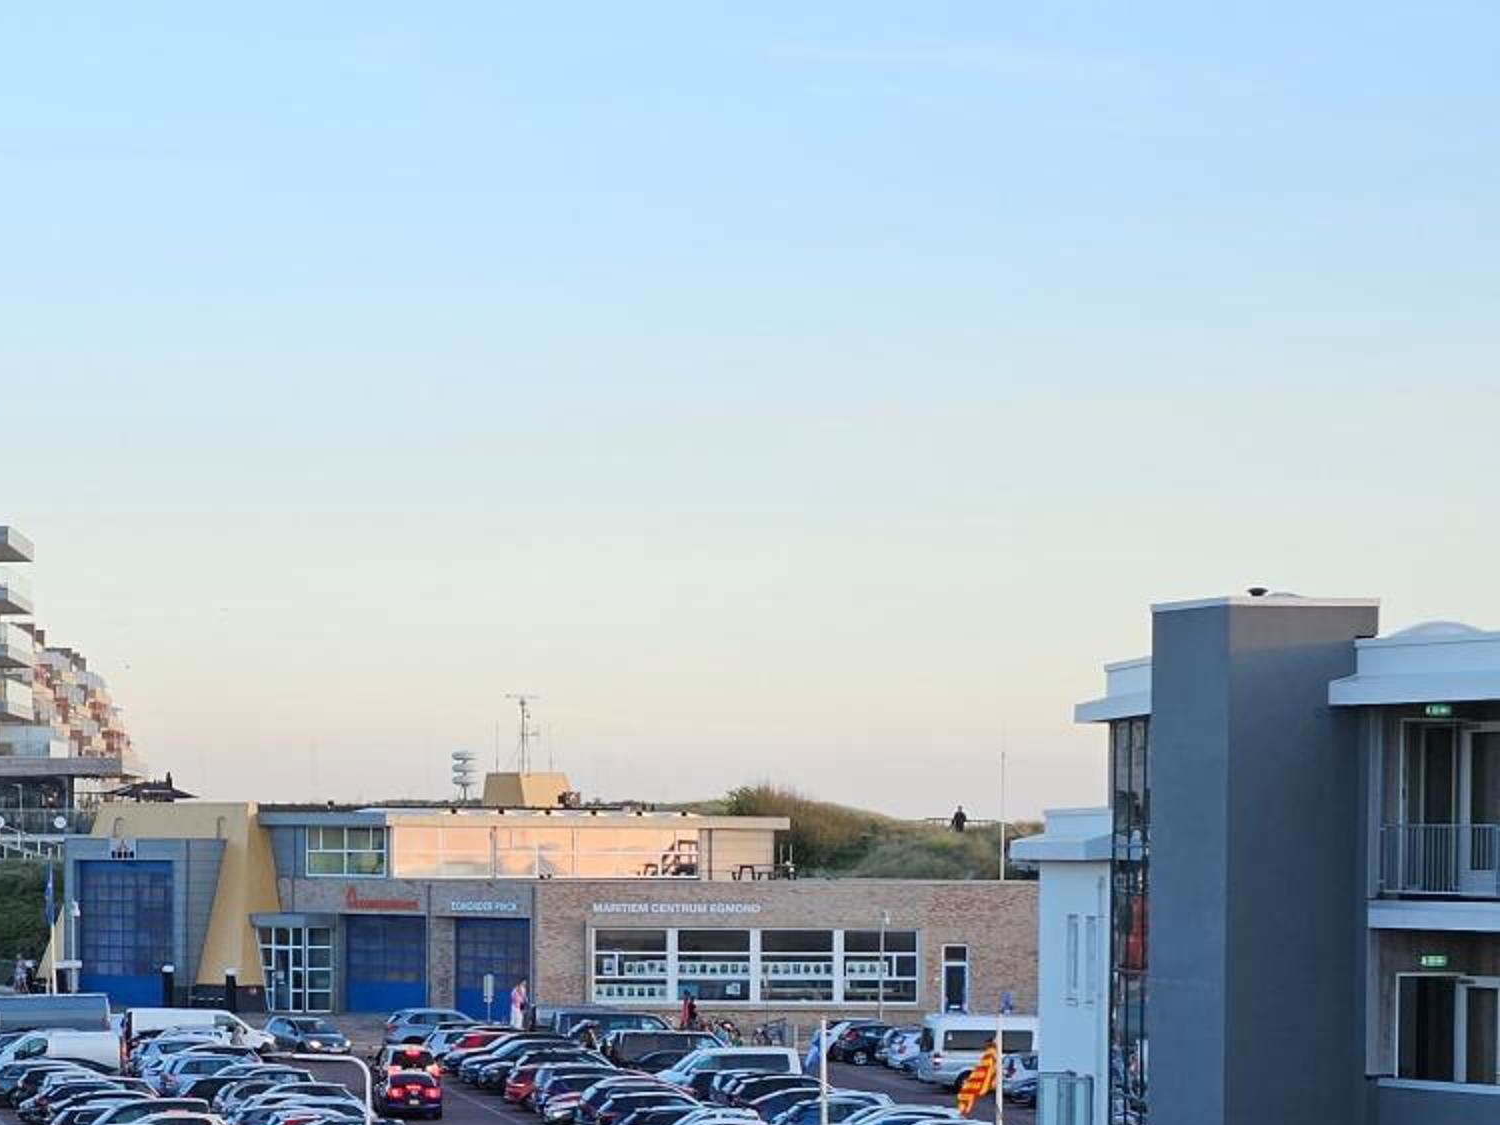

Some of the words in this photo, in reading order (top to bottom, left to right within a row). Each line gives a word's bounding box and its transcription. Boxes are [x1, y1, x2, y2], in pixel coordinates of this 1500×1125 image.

[593, 902, 649, 913] MARITIEM
[651, 902, 707, 913] CENTRUM
[709, 902, 761, 913] EGMOND
